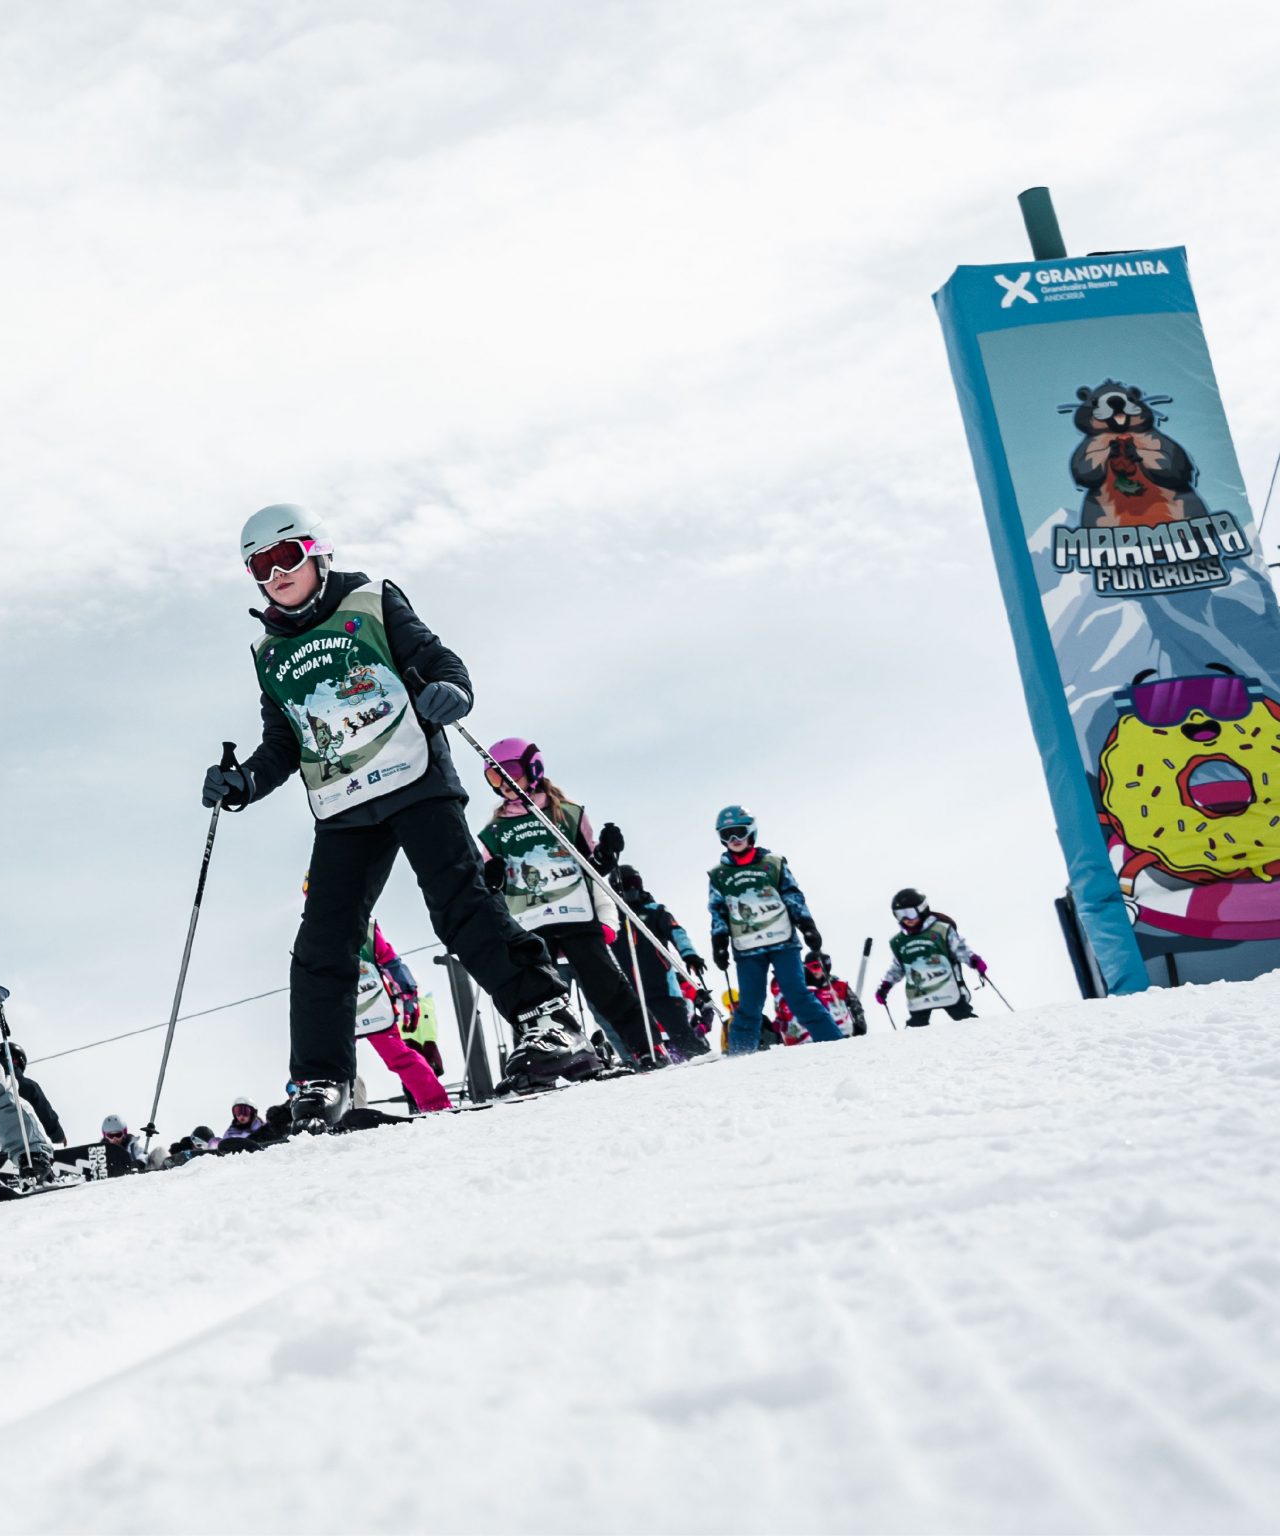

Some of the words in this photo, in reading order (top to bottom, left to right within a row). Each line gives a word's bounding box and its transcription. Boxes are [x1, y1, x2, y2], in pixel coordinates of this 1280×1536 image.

[1035, 260, 1169, 285] GRANDVALIRA
[1055, 513, 1246, 568] MARMOTA
[1097, 565, 1145, 591] FUN
[1148, 560, 1225, 588] CROSS
[291, 637, 353, 664] IMPORTANT!
[292, 653, 333, 680] CUIDA'M
